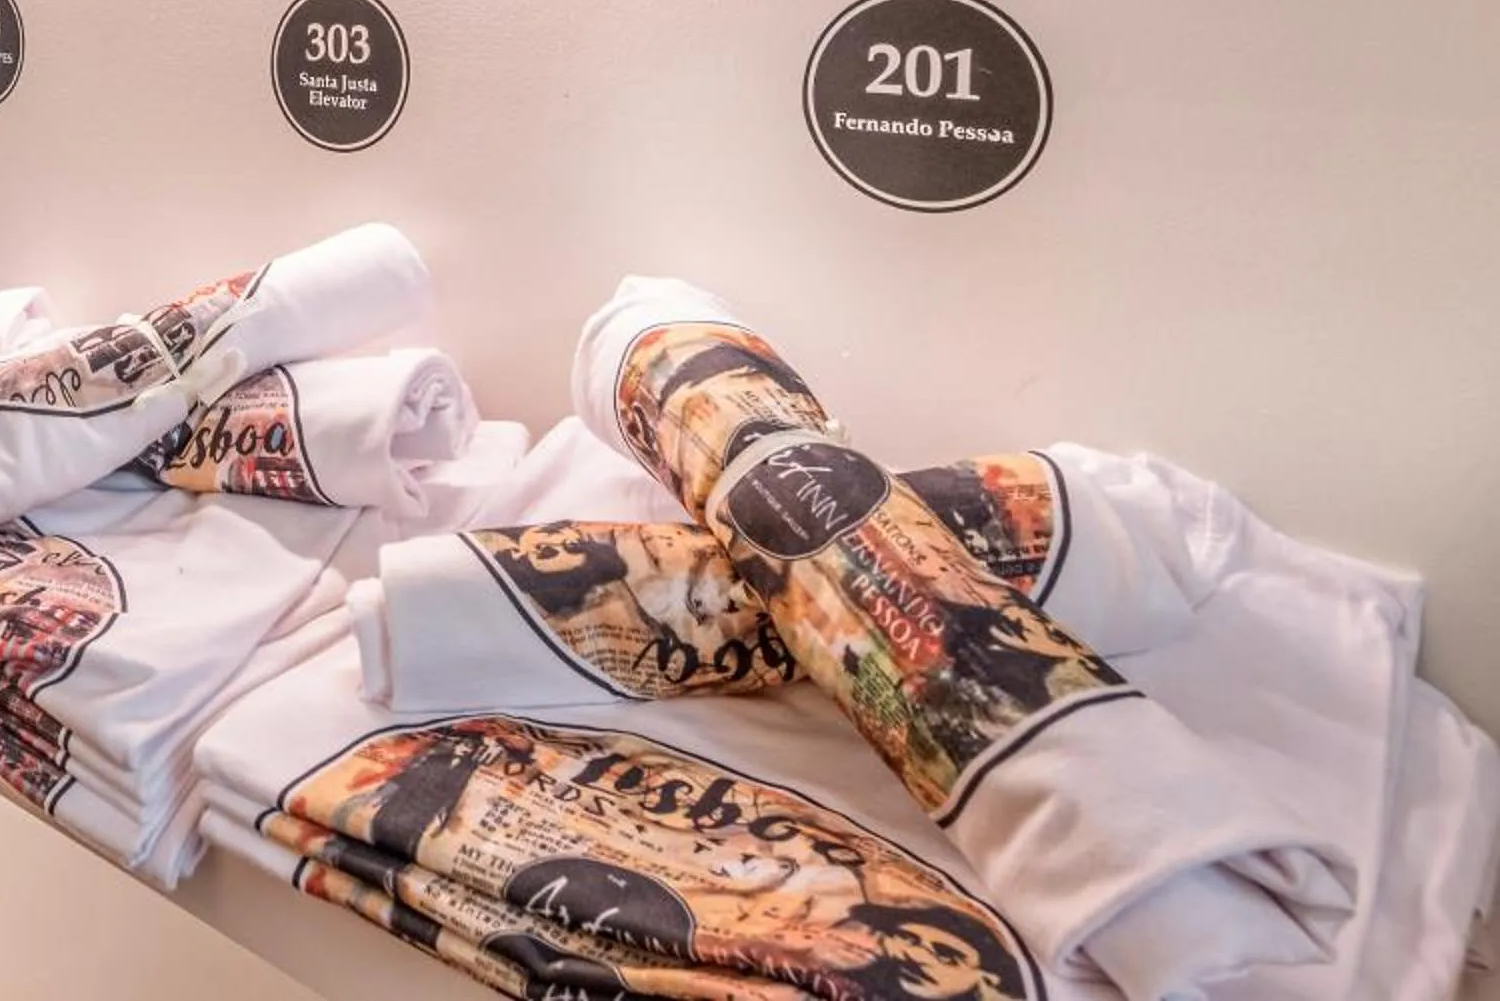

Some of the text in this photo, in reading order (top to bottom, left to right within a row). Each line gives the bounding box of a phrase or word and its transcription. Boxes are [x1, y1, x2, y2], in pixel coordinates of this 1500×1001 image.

[304, 22, 372, 65] 303
[299, 71, 378, 93] Santa Justa
[864, 42, 981, 102] 201
[309, 90, 369, 111] Elevator
[833, 110, 1015, 145] Fernando Pessoa
[850, 573, 921, 660] PESSOA
